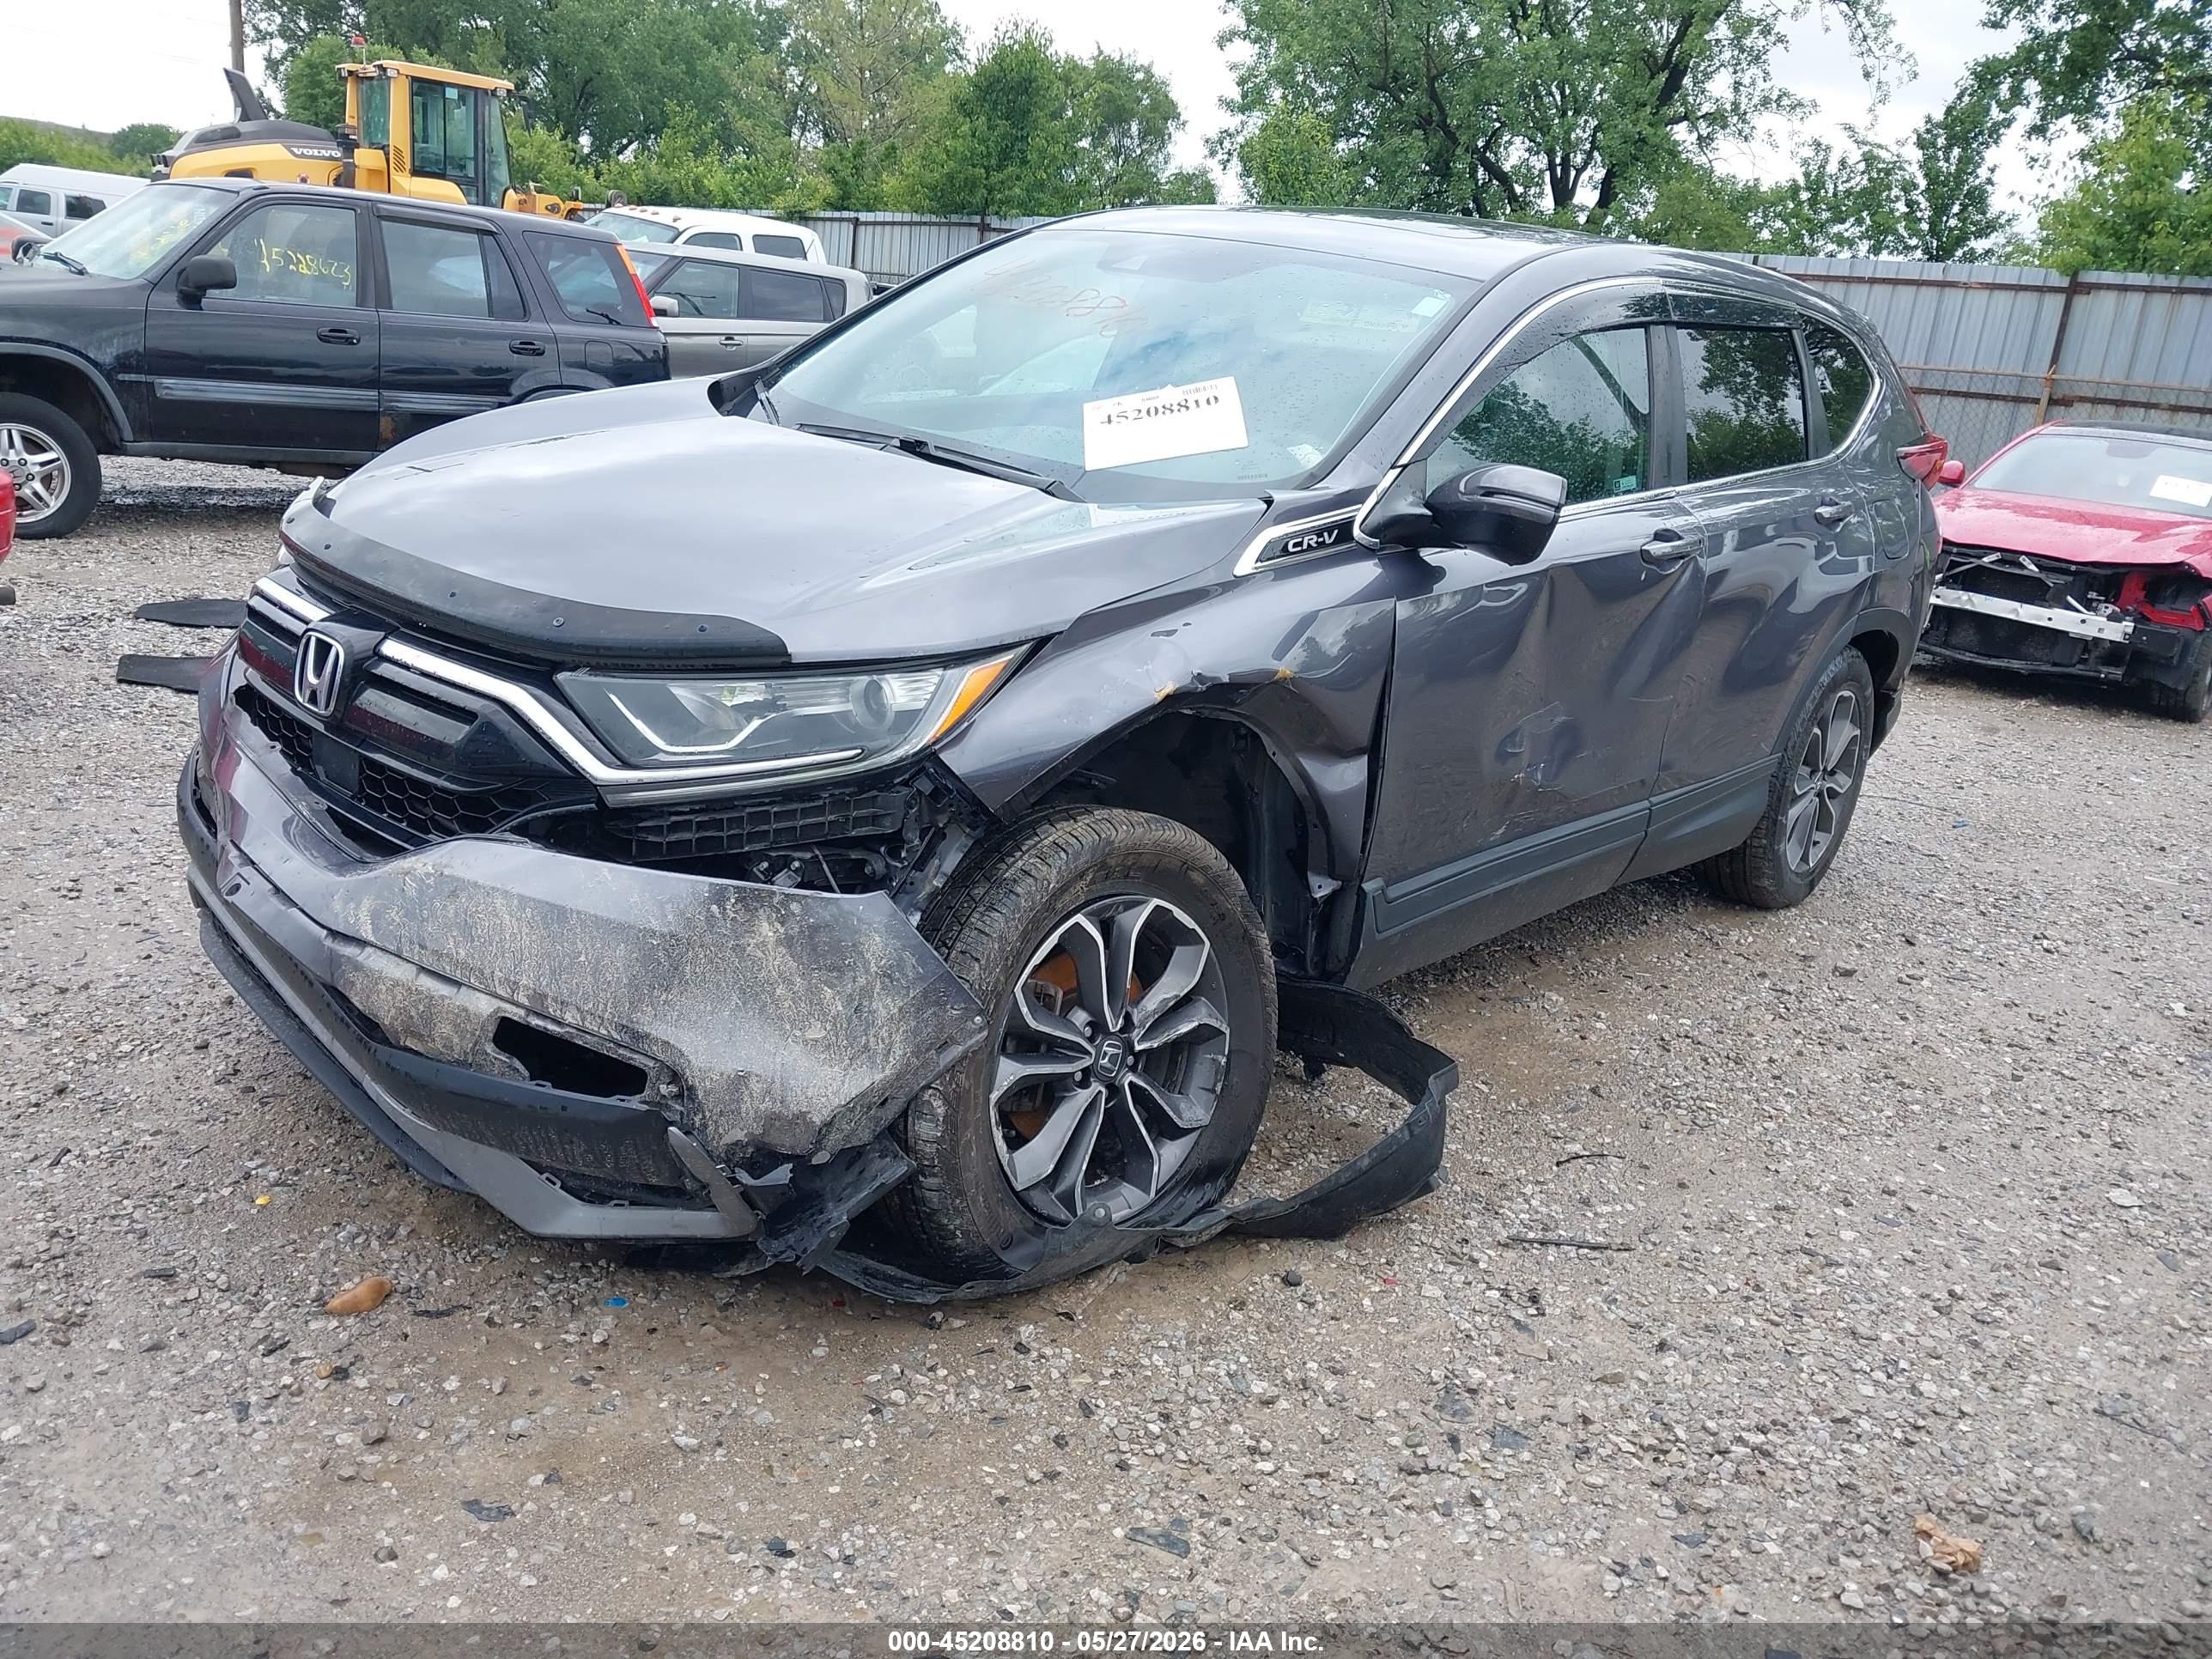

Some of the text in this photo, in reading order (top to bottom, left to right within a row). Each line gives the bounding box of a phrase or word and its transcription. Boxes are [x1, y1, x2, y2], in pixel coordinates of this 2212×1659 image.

[290, 147, 342, 158] VOLVO
[1100, 395, 1220, 425] 45208810
[1287, 528, 1340, 553] CR-V
